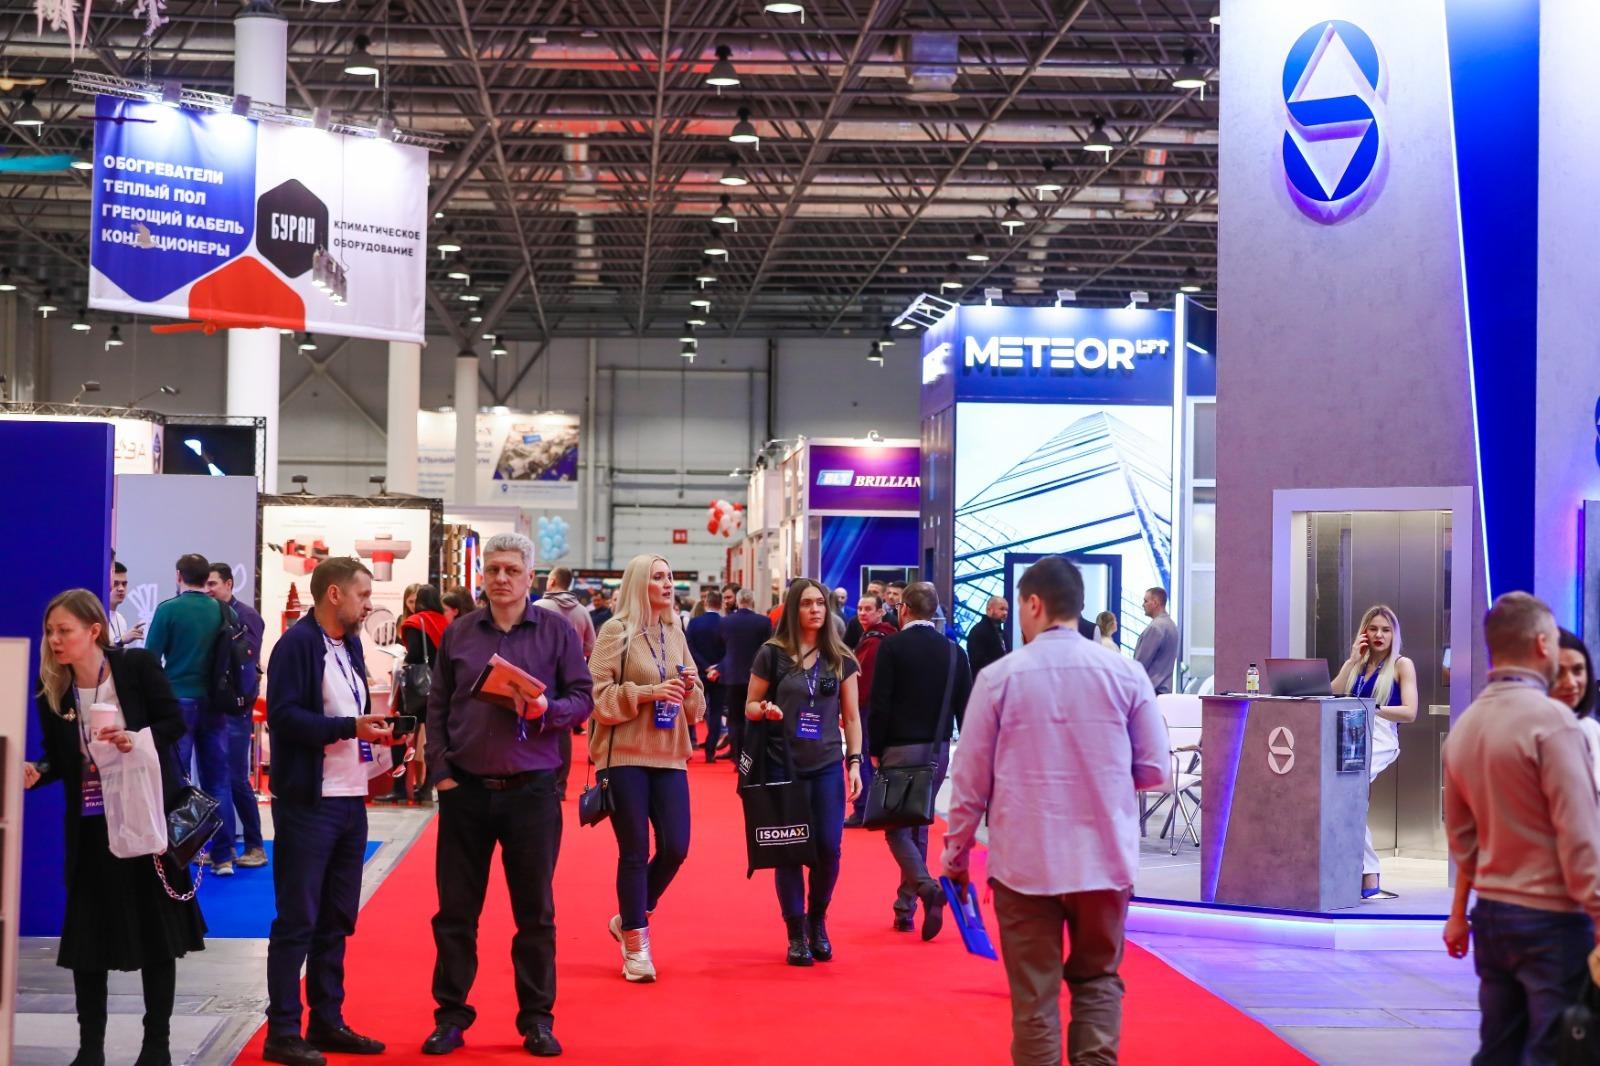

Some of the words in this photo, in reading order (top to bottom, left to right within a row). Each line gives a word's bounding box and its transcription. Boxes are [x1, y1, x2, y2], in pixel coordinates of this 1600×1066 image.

[103, 155, 224, 185] ОБОГРЕВАТЕЛИ
[102, 178, 170, 201] ТЕПЛЫЙ
[173, 188, 207, 206] ПОЛ
[101, 203, 182, 227] ГРЕЮЩИЙ
[185, 213, 245, 235] КАБЕЛЬ
[271, 212, 315, 245] БУРАН
[333, 220, 421, 241] КЛИМАТИЧЕСКОЕ
[333, 238, 414, 257] ОБОРУДОВАНИЕ
[965, 336, 1135, 370] METEOR
[760, 827, 805, 840] ISOMAX
